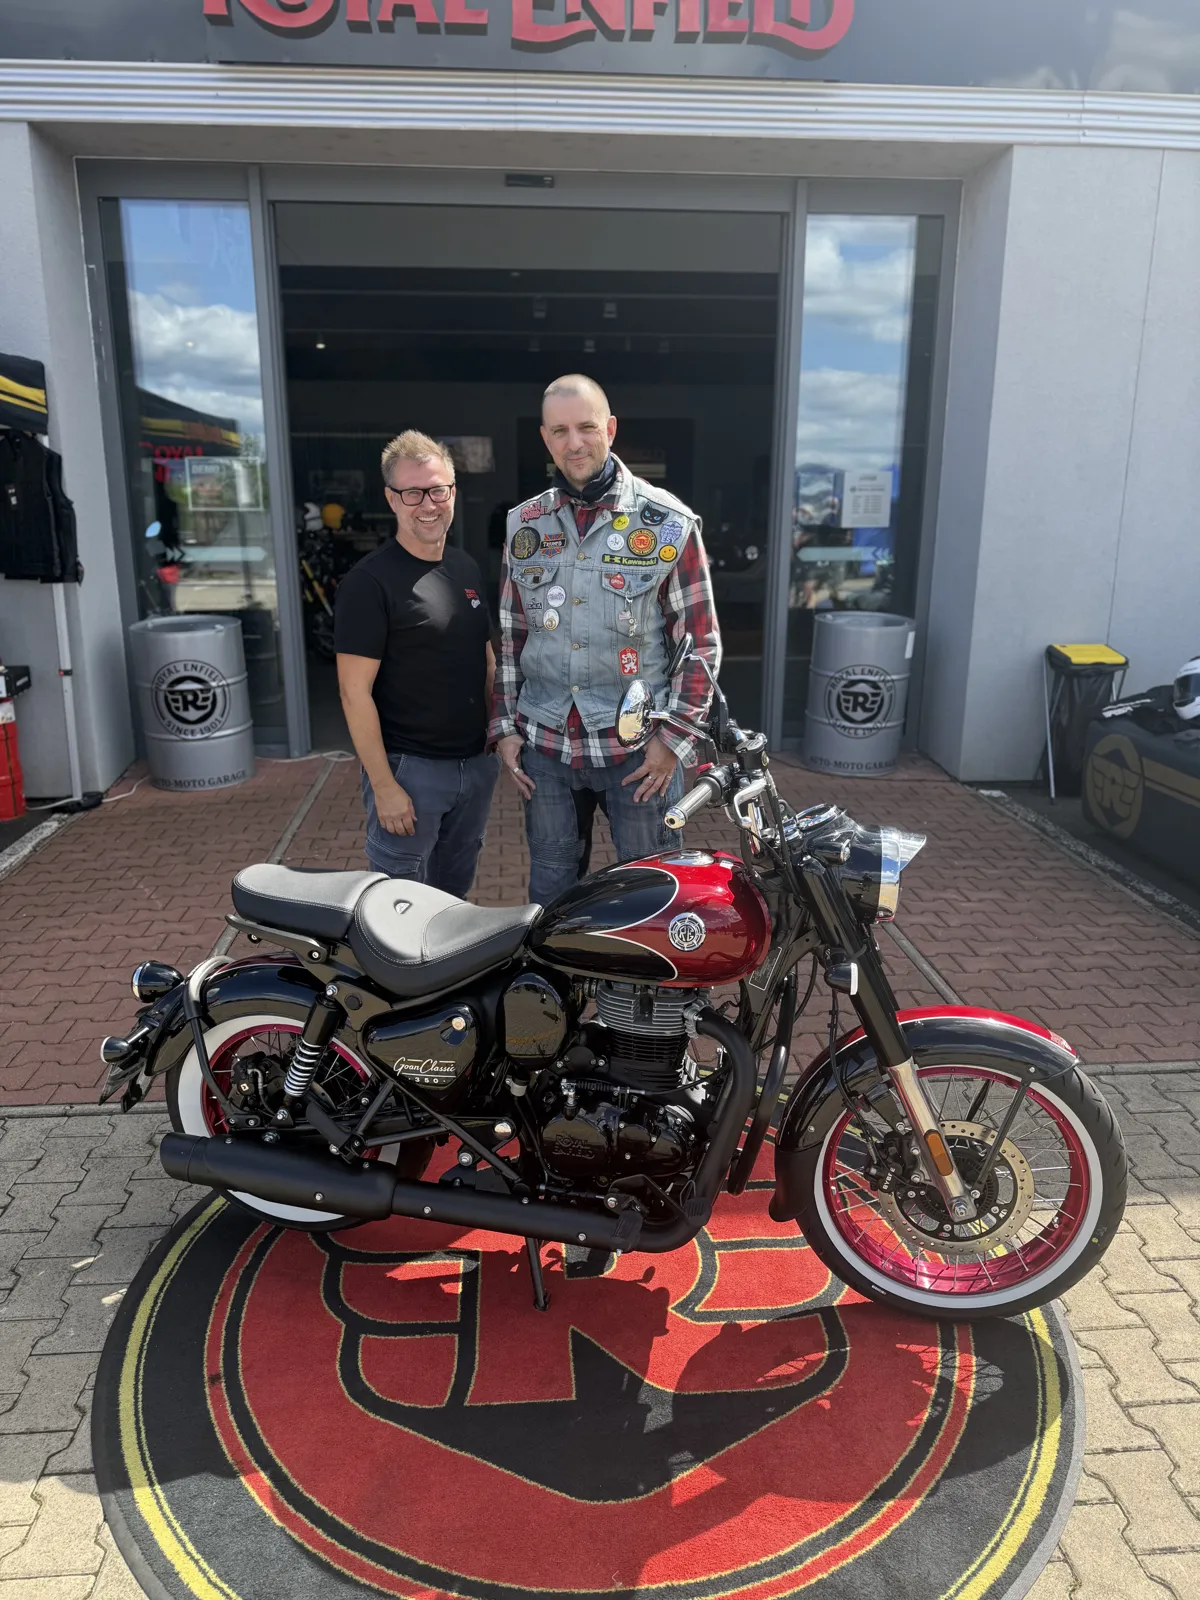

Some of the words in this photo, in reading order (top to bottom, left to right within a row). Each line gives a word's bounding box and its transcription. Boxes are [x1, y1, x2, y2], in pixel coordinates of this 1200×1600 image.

[622, 557, 657, 567] Kawasaki
[393, 1056, 420, 1076] Goan
[419, 1058, 456, 1074] Classic
